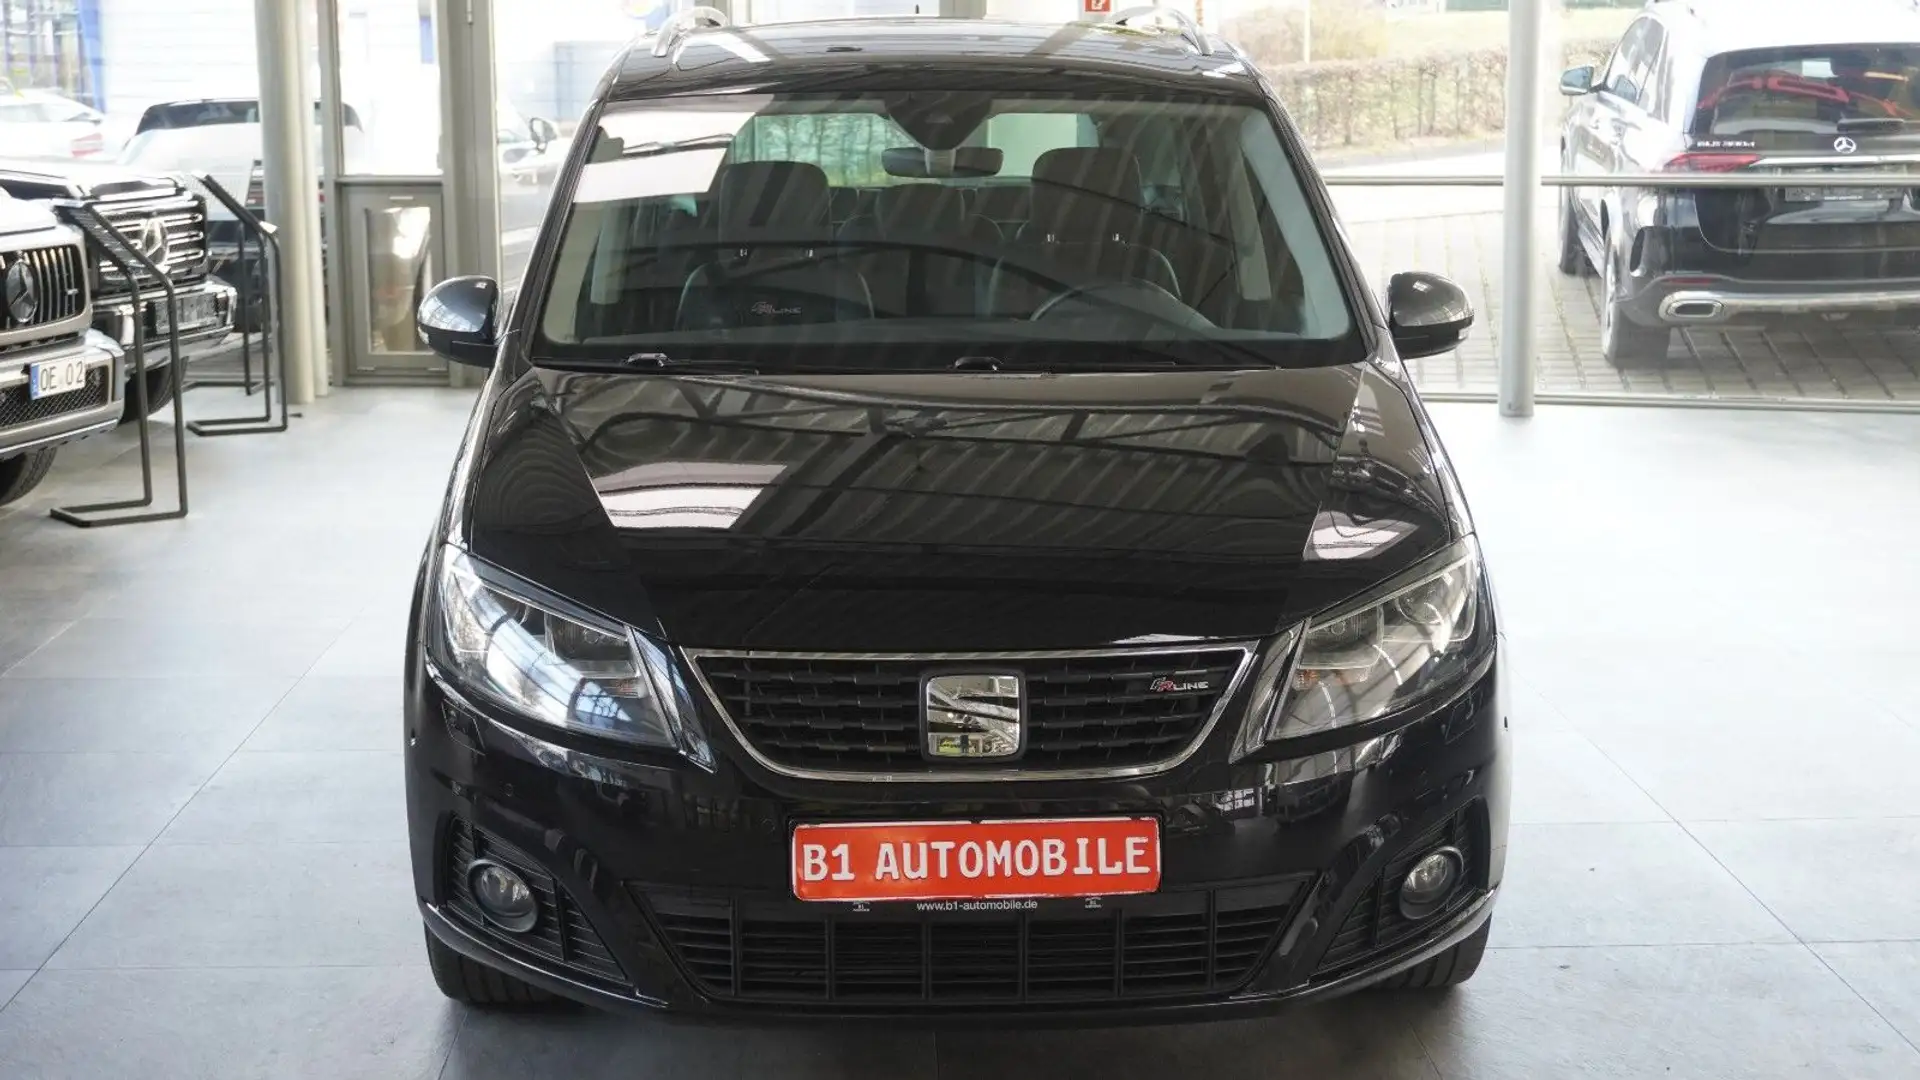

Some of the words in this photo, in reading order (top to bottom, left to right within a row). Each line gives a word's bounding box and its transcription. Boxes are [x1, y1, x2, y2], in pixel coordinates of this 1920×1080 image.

[40, 366, 57, 391] OE
[65, 360, 83, 386] 02
[803, 843, 855, 881] B1
[875, 836, 1151, 880] AUTOMOBILE
[916, 900, 1038, 911] www.b1-automobile.de
